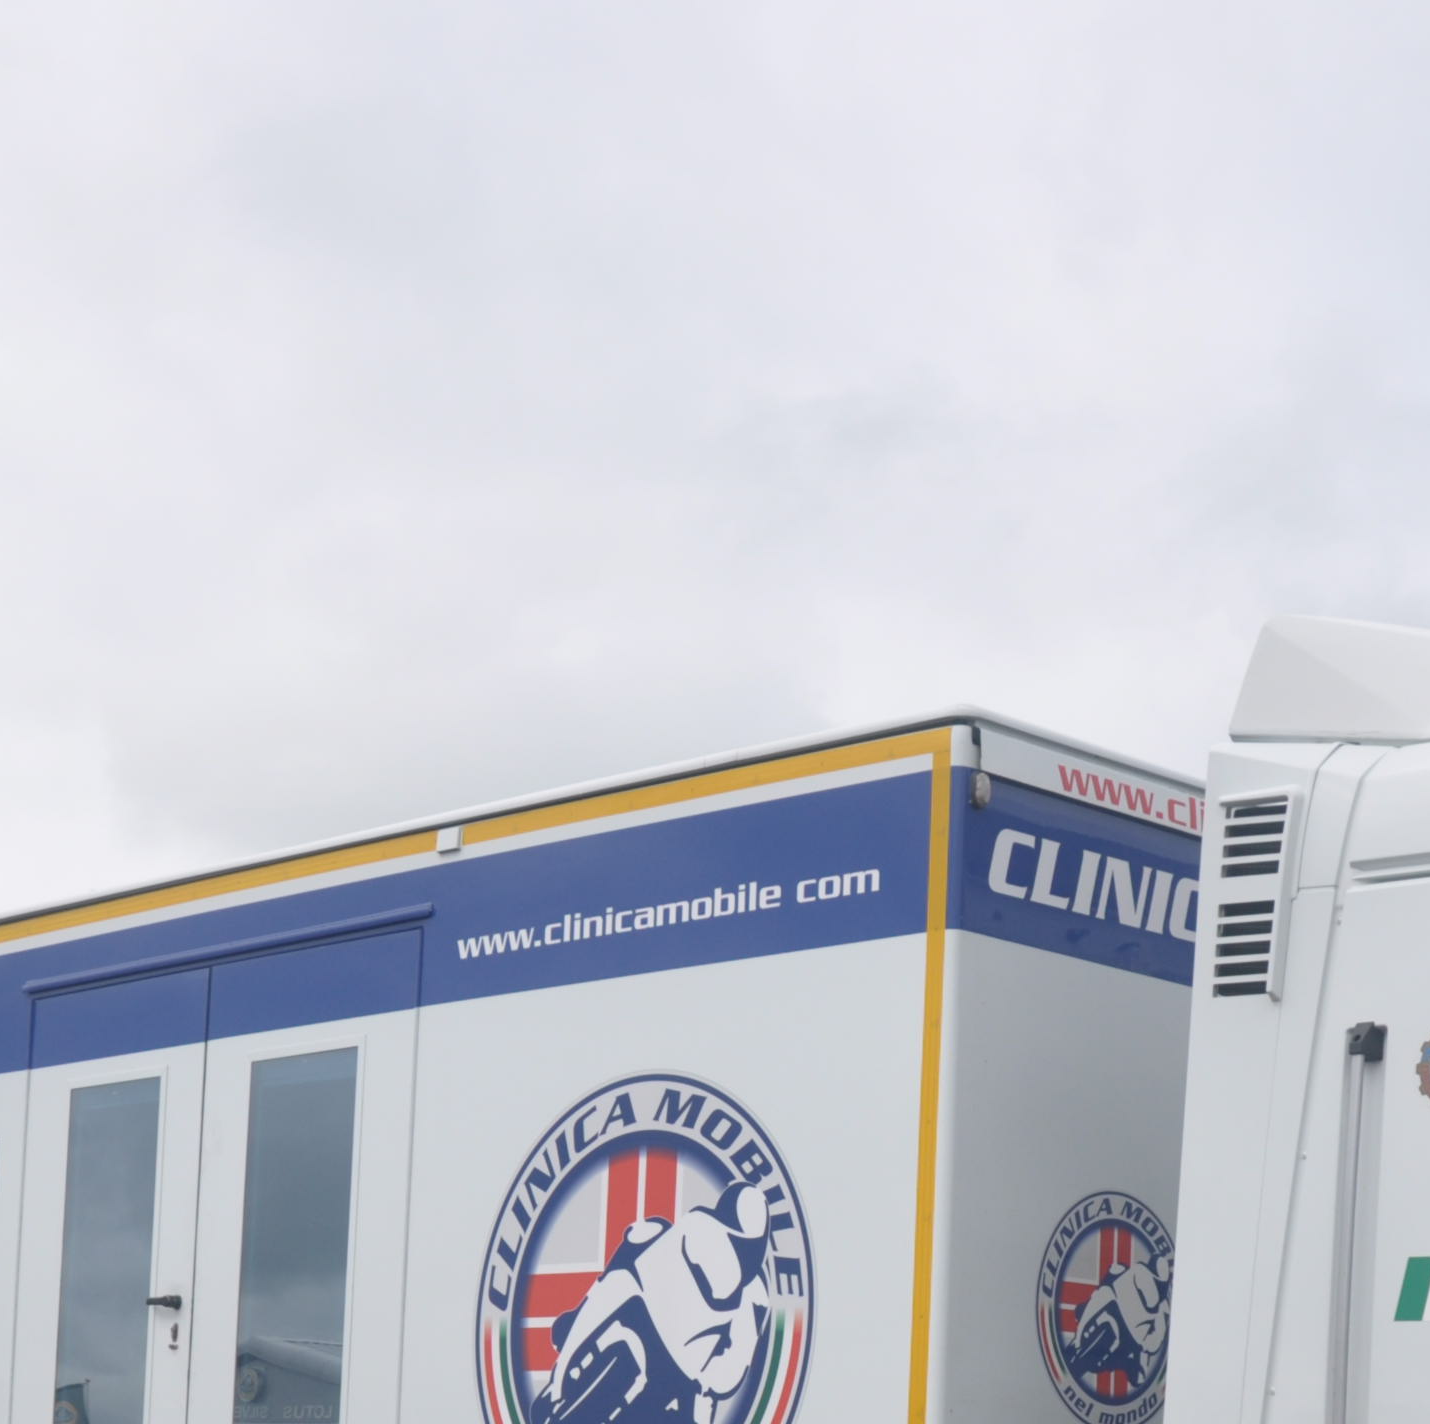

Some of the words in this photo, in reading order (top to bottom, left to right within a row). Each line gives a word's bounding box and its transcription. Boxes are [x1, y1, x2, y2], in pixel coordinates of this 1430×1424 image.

[987, 827, 1200, 944] CLINIC
[486, 1091, 638, 1313] CLINICA
[652, 1087, 806, 1299] MOBILE
[1041, 1197, 1113, 1298] CLINICA
[1063, 1385, 1093, 1419] nel
